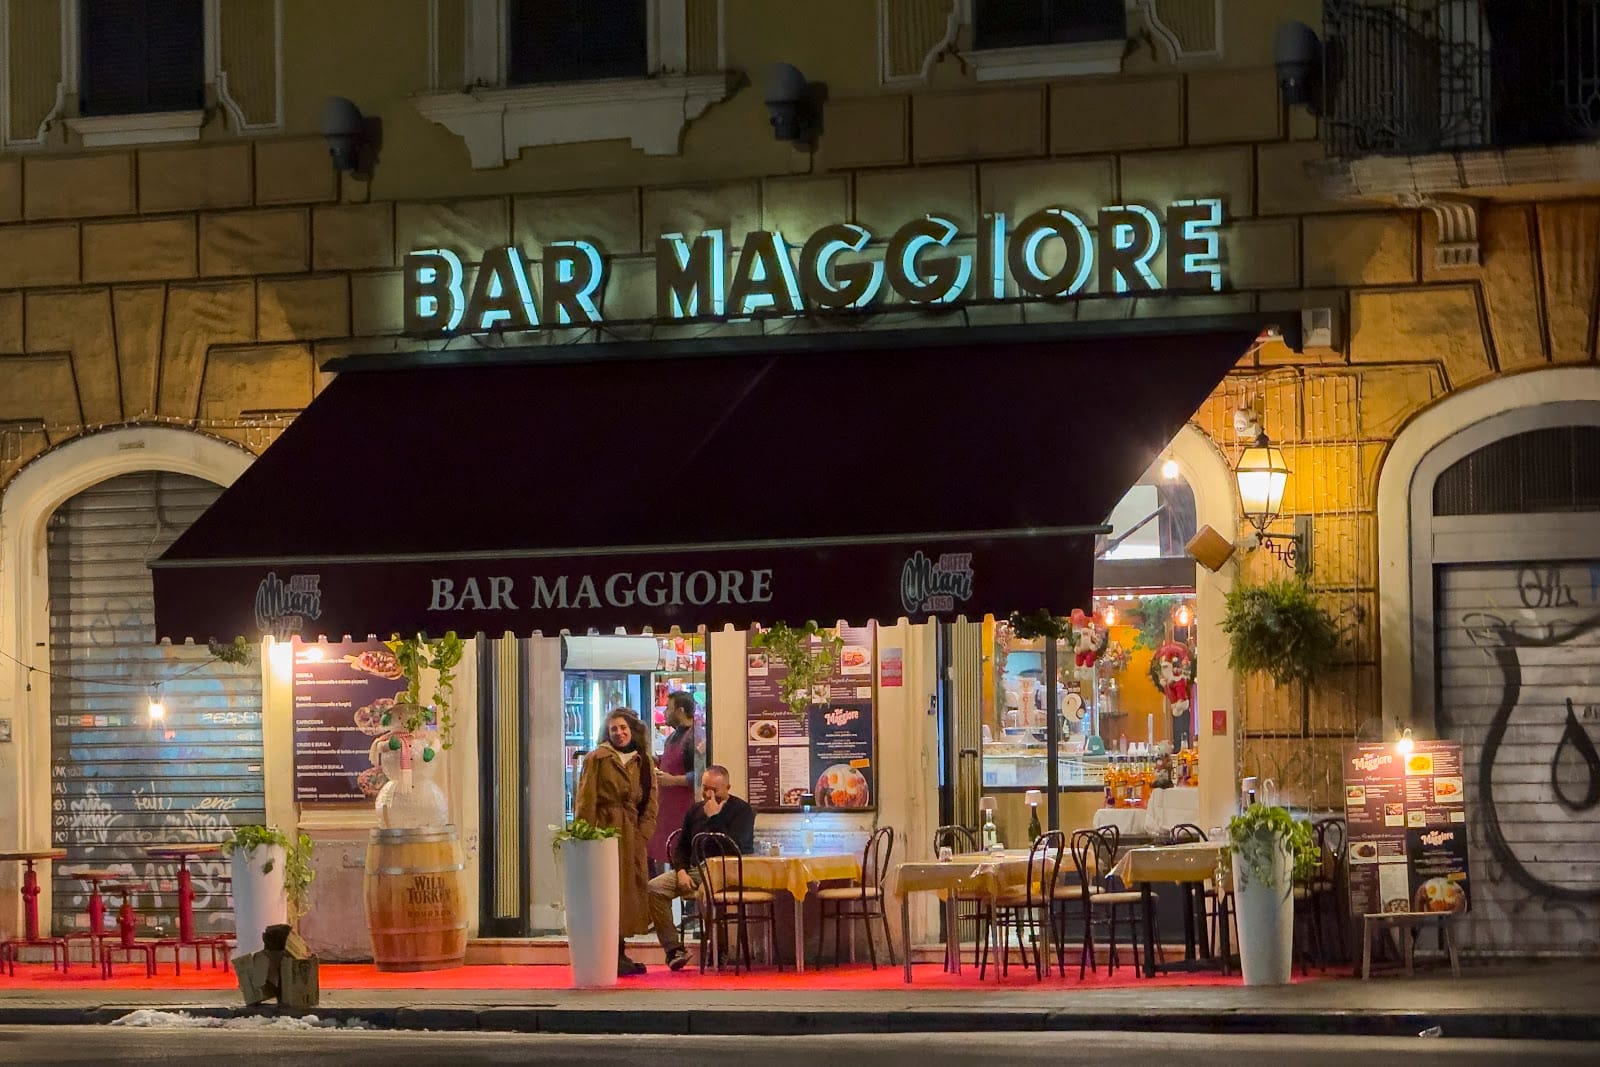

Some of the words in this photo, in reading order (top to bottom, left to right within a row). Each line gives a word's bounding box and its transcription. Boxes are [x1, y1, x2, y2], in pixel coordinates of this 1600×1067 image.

[402, 241, 603, 333] BAR
[655, 199, 1222, 319] MAGGIORE
[427, 576, 519, 611] BAR
[531, 569, 773, 609] MAGGIORE
